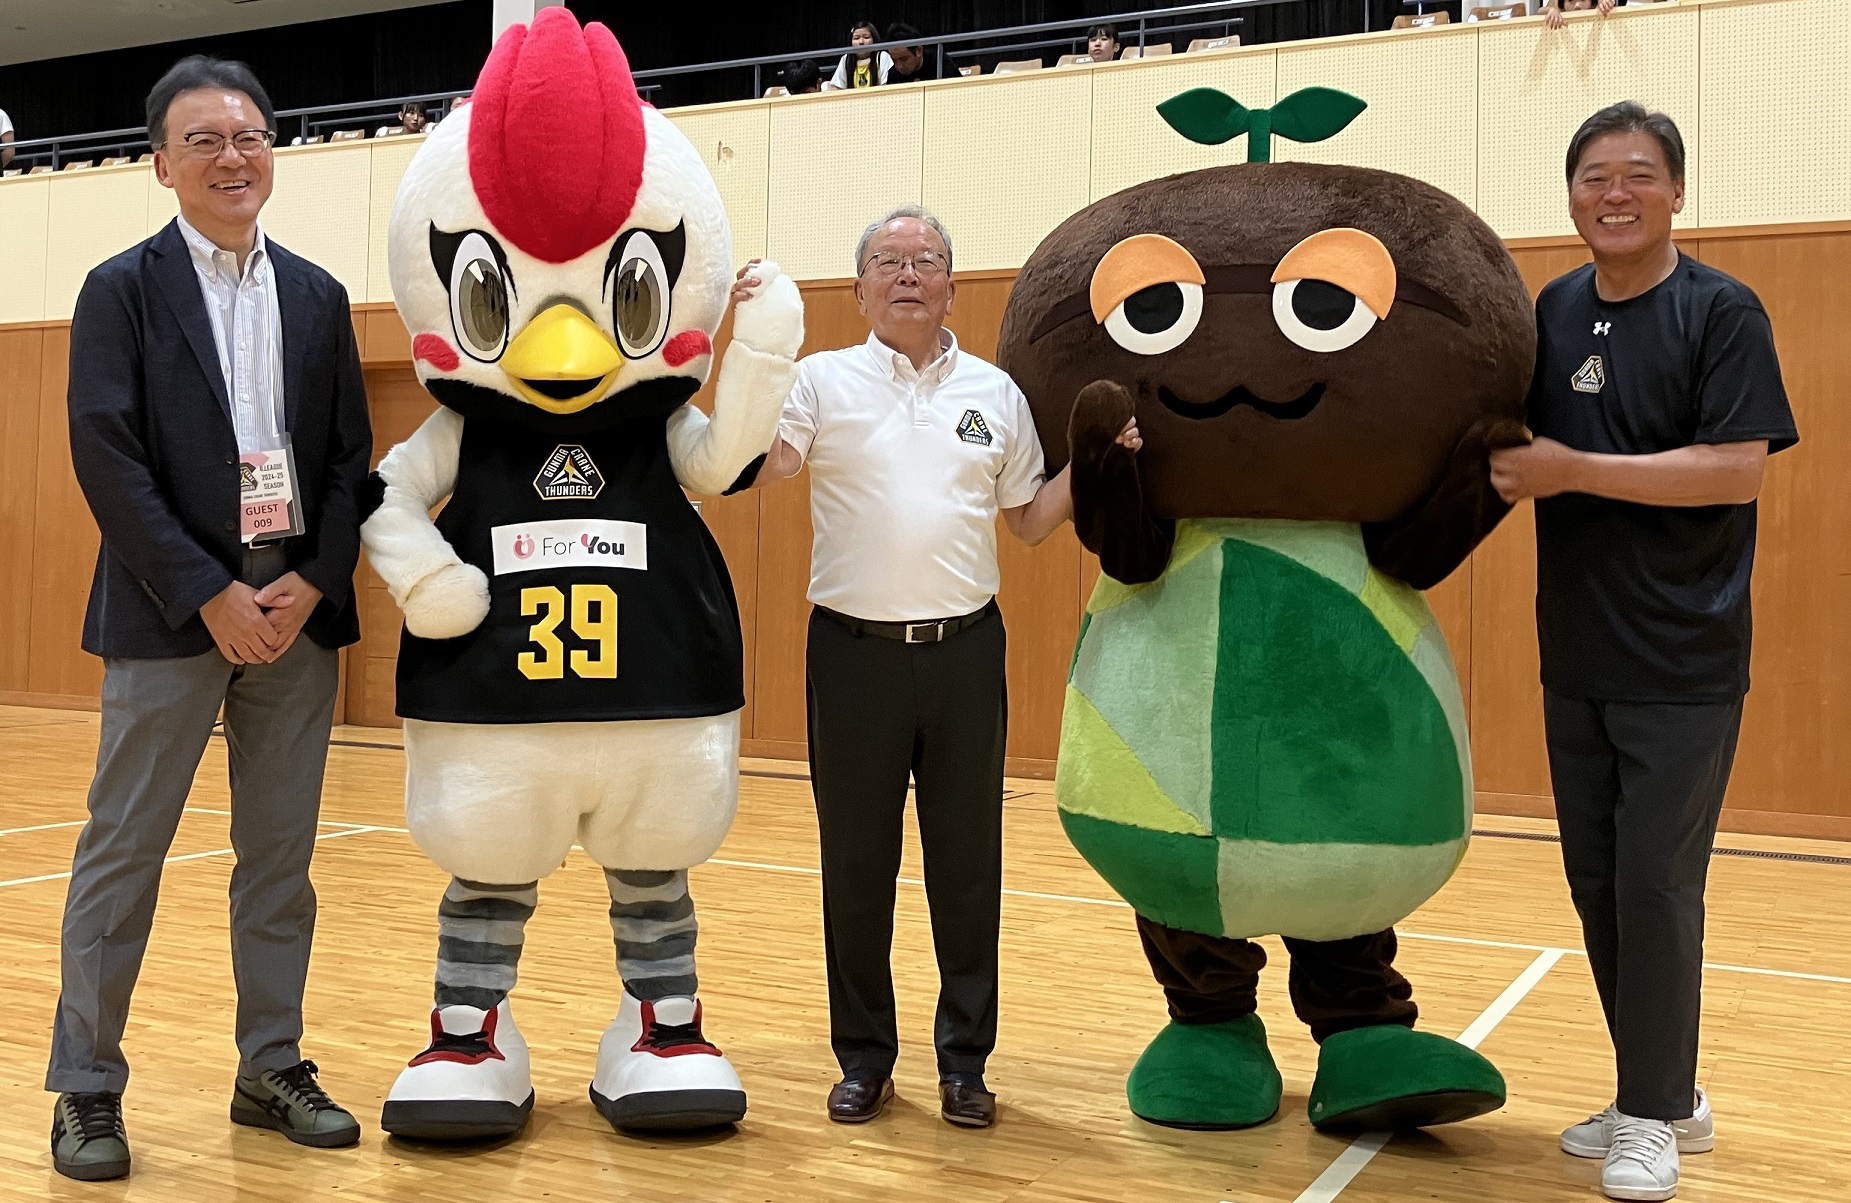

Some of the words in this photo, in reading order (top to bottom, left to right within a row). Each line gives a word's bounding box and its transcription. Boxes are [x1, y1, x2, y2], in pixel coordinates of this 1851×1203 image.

[543, 448, 569, 478] GUNMA
[570, 448, 595, 477] CRANE
[261, 472, 284, 480] 2024-25
[264, 481, 284, 490] SEASON
[545, 485, 593, 496] THUNDERS
[245, 504, 279, 516] GUEST
[254, 518, 272, 528] 009
[543, 535, 576, 556] For
[581, 533, 625, 556] You
[517, 584, 618, 680] 39
